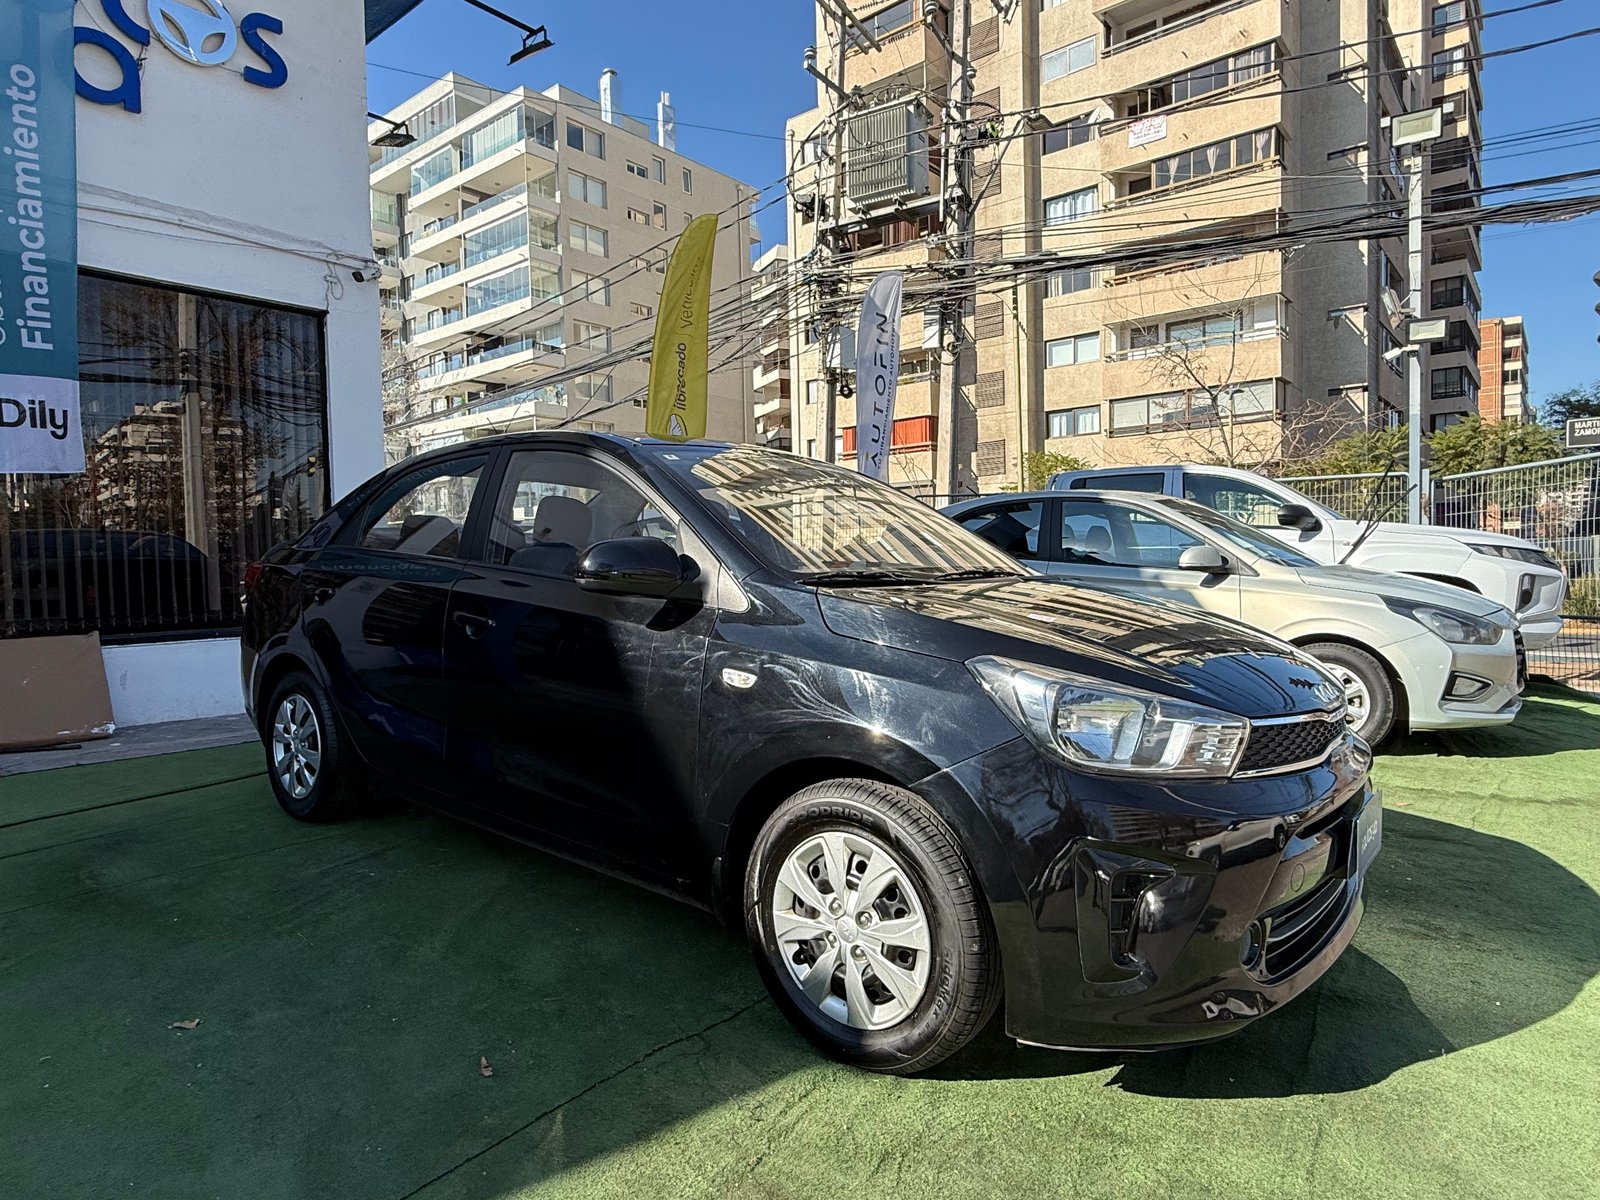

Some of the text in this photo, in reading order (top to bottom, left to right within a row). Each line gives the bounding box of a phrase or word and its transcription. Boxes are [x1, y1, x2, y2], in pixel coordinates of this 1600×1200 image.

[4, 63, 54, 351] Financiamiento
[871, 311, 889, 468] AUTOFIN
[880, 378, 893, 456] FINANCIAMIENTO
